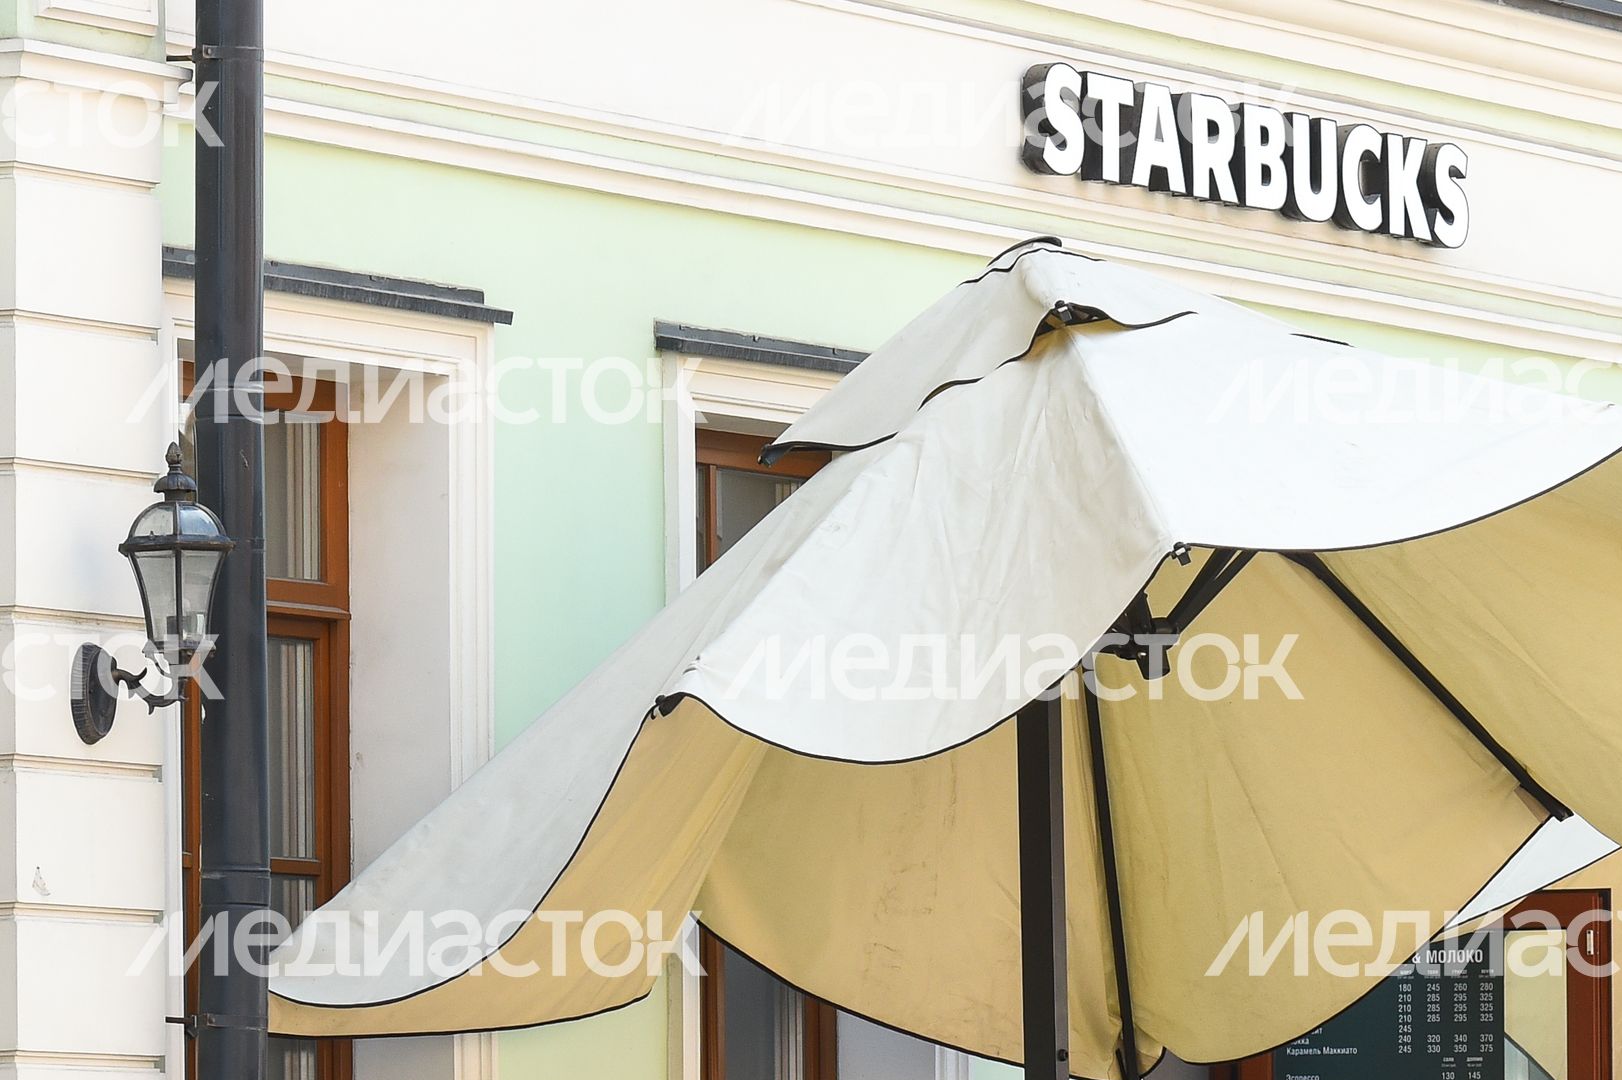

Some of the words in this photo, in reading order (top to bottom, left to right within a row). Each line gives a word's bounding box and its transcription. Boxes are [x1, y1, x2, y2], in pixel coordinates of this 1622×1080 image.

[1023, 62, 1470, 249] STARBUCKS
[1426, 950, 1483, 964] МОЛОКО
[1399, 984, 1412, 992] 180
[1454, 983, 1467, 991] 260
[1399, 994, 1412, 1002] 210
[1454, 993, 1467, 1001] 295
[1480, 993, 1493, 1001] 325
[1427, 1004, 1440, 1012] 285
[1427, 1014, 1440, 1022] 285
[1454, 1014, 1467, 1022] 295
[1399, 1035, 1412, 1043] 240
[1454, 1034, 1467, 1042] 340
[1480, 1034, 1493, 1042] 370
[1286, 1047, 1321, 1056] Карамель
[1323, 1047, 1357, 1055] Маккиато
[1427, 1045, 1440, 1053] 330
[1480, 1044, 1493, 1052] 375
[1442, 1072, 1455, 1080] 130
